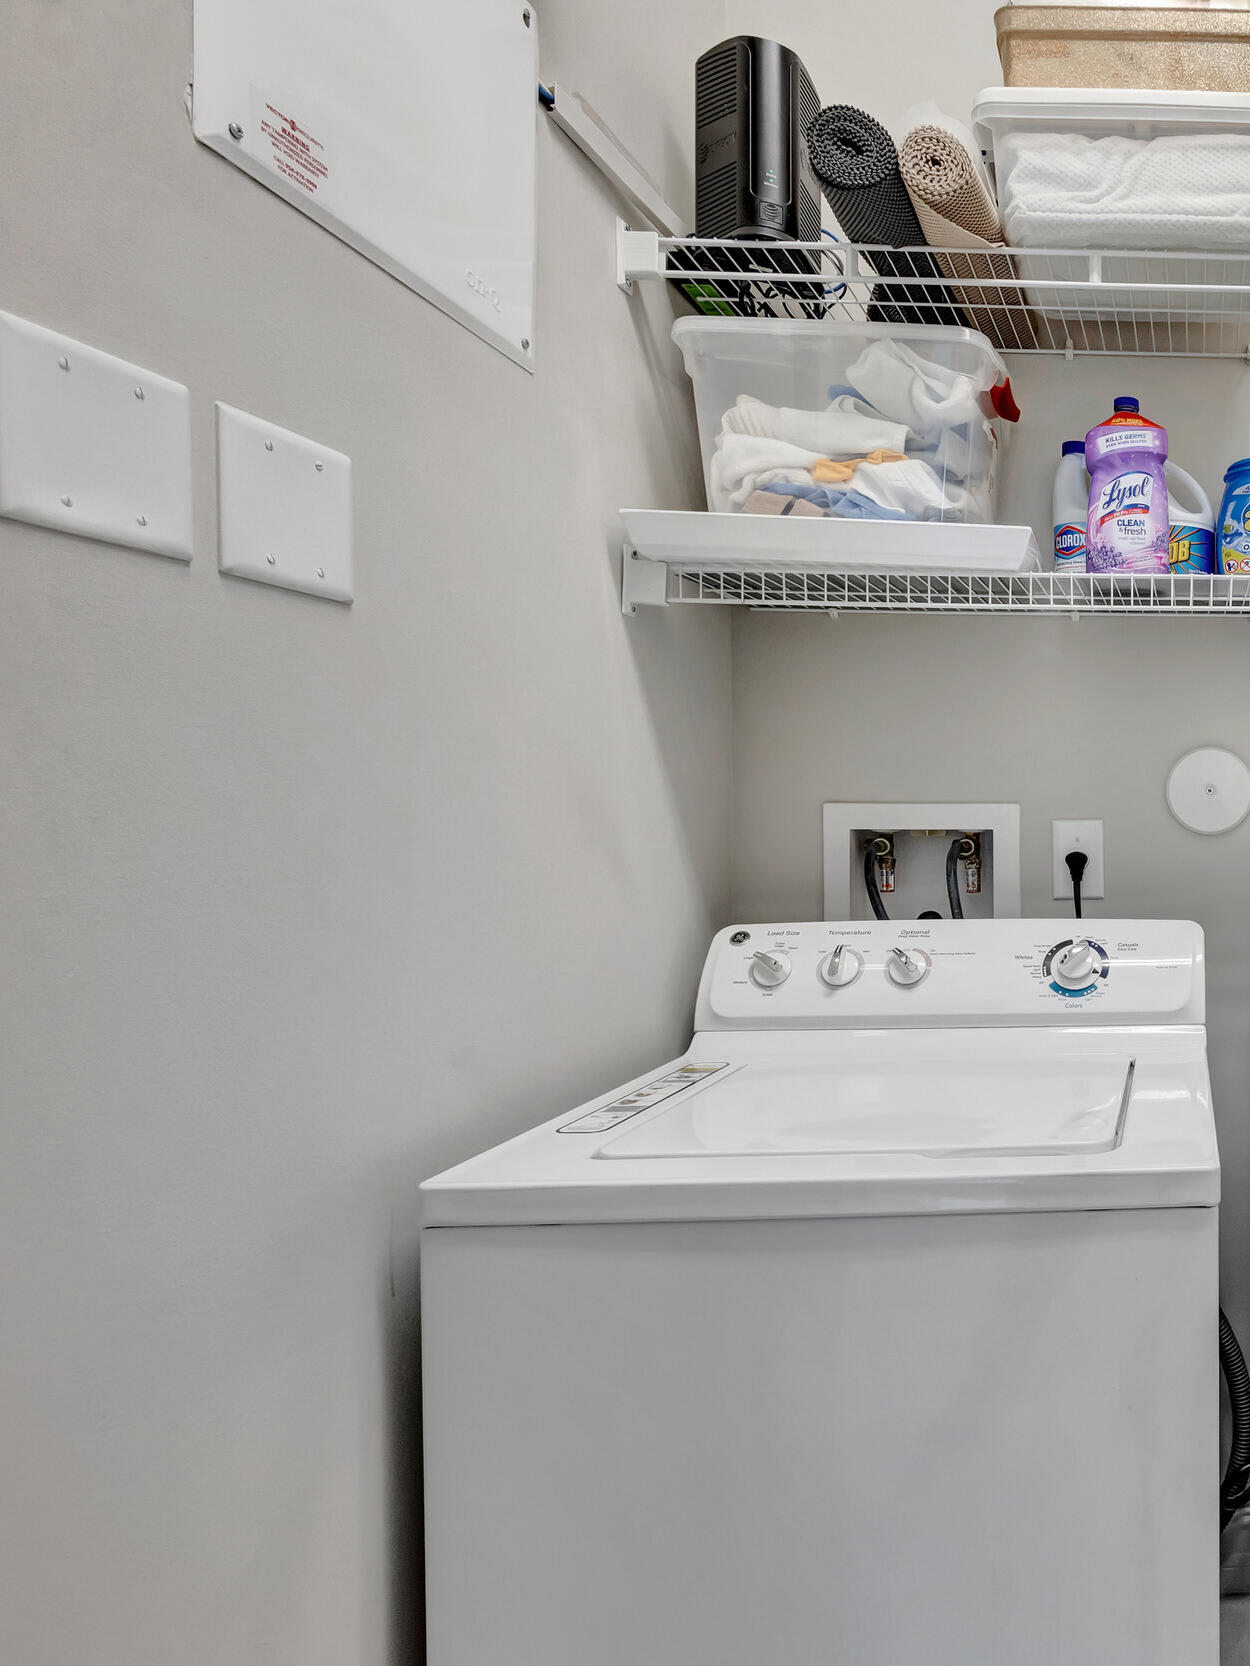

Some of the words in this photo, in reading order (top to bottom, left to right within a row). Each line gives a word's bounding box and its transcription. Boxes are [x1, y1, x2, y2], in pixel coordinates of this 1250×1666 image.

[1105, 434, 1123, 443] KILLS
[1102, 476, 1149, 510] Lysol
[1124, 527, 1146, 535] fresh
[1056, 534, 1087, 549] CLOROX
